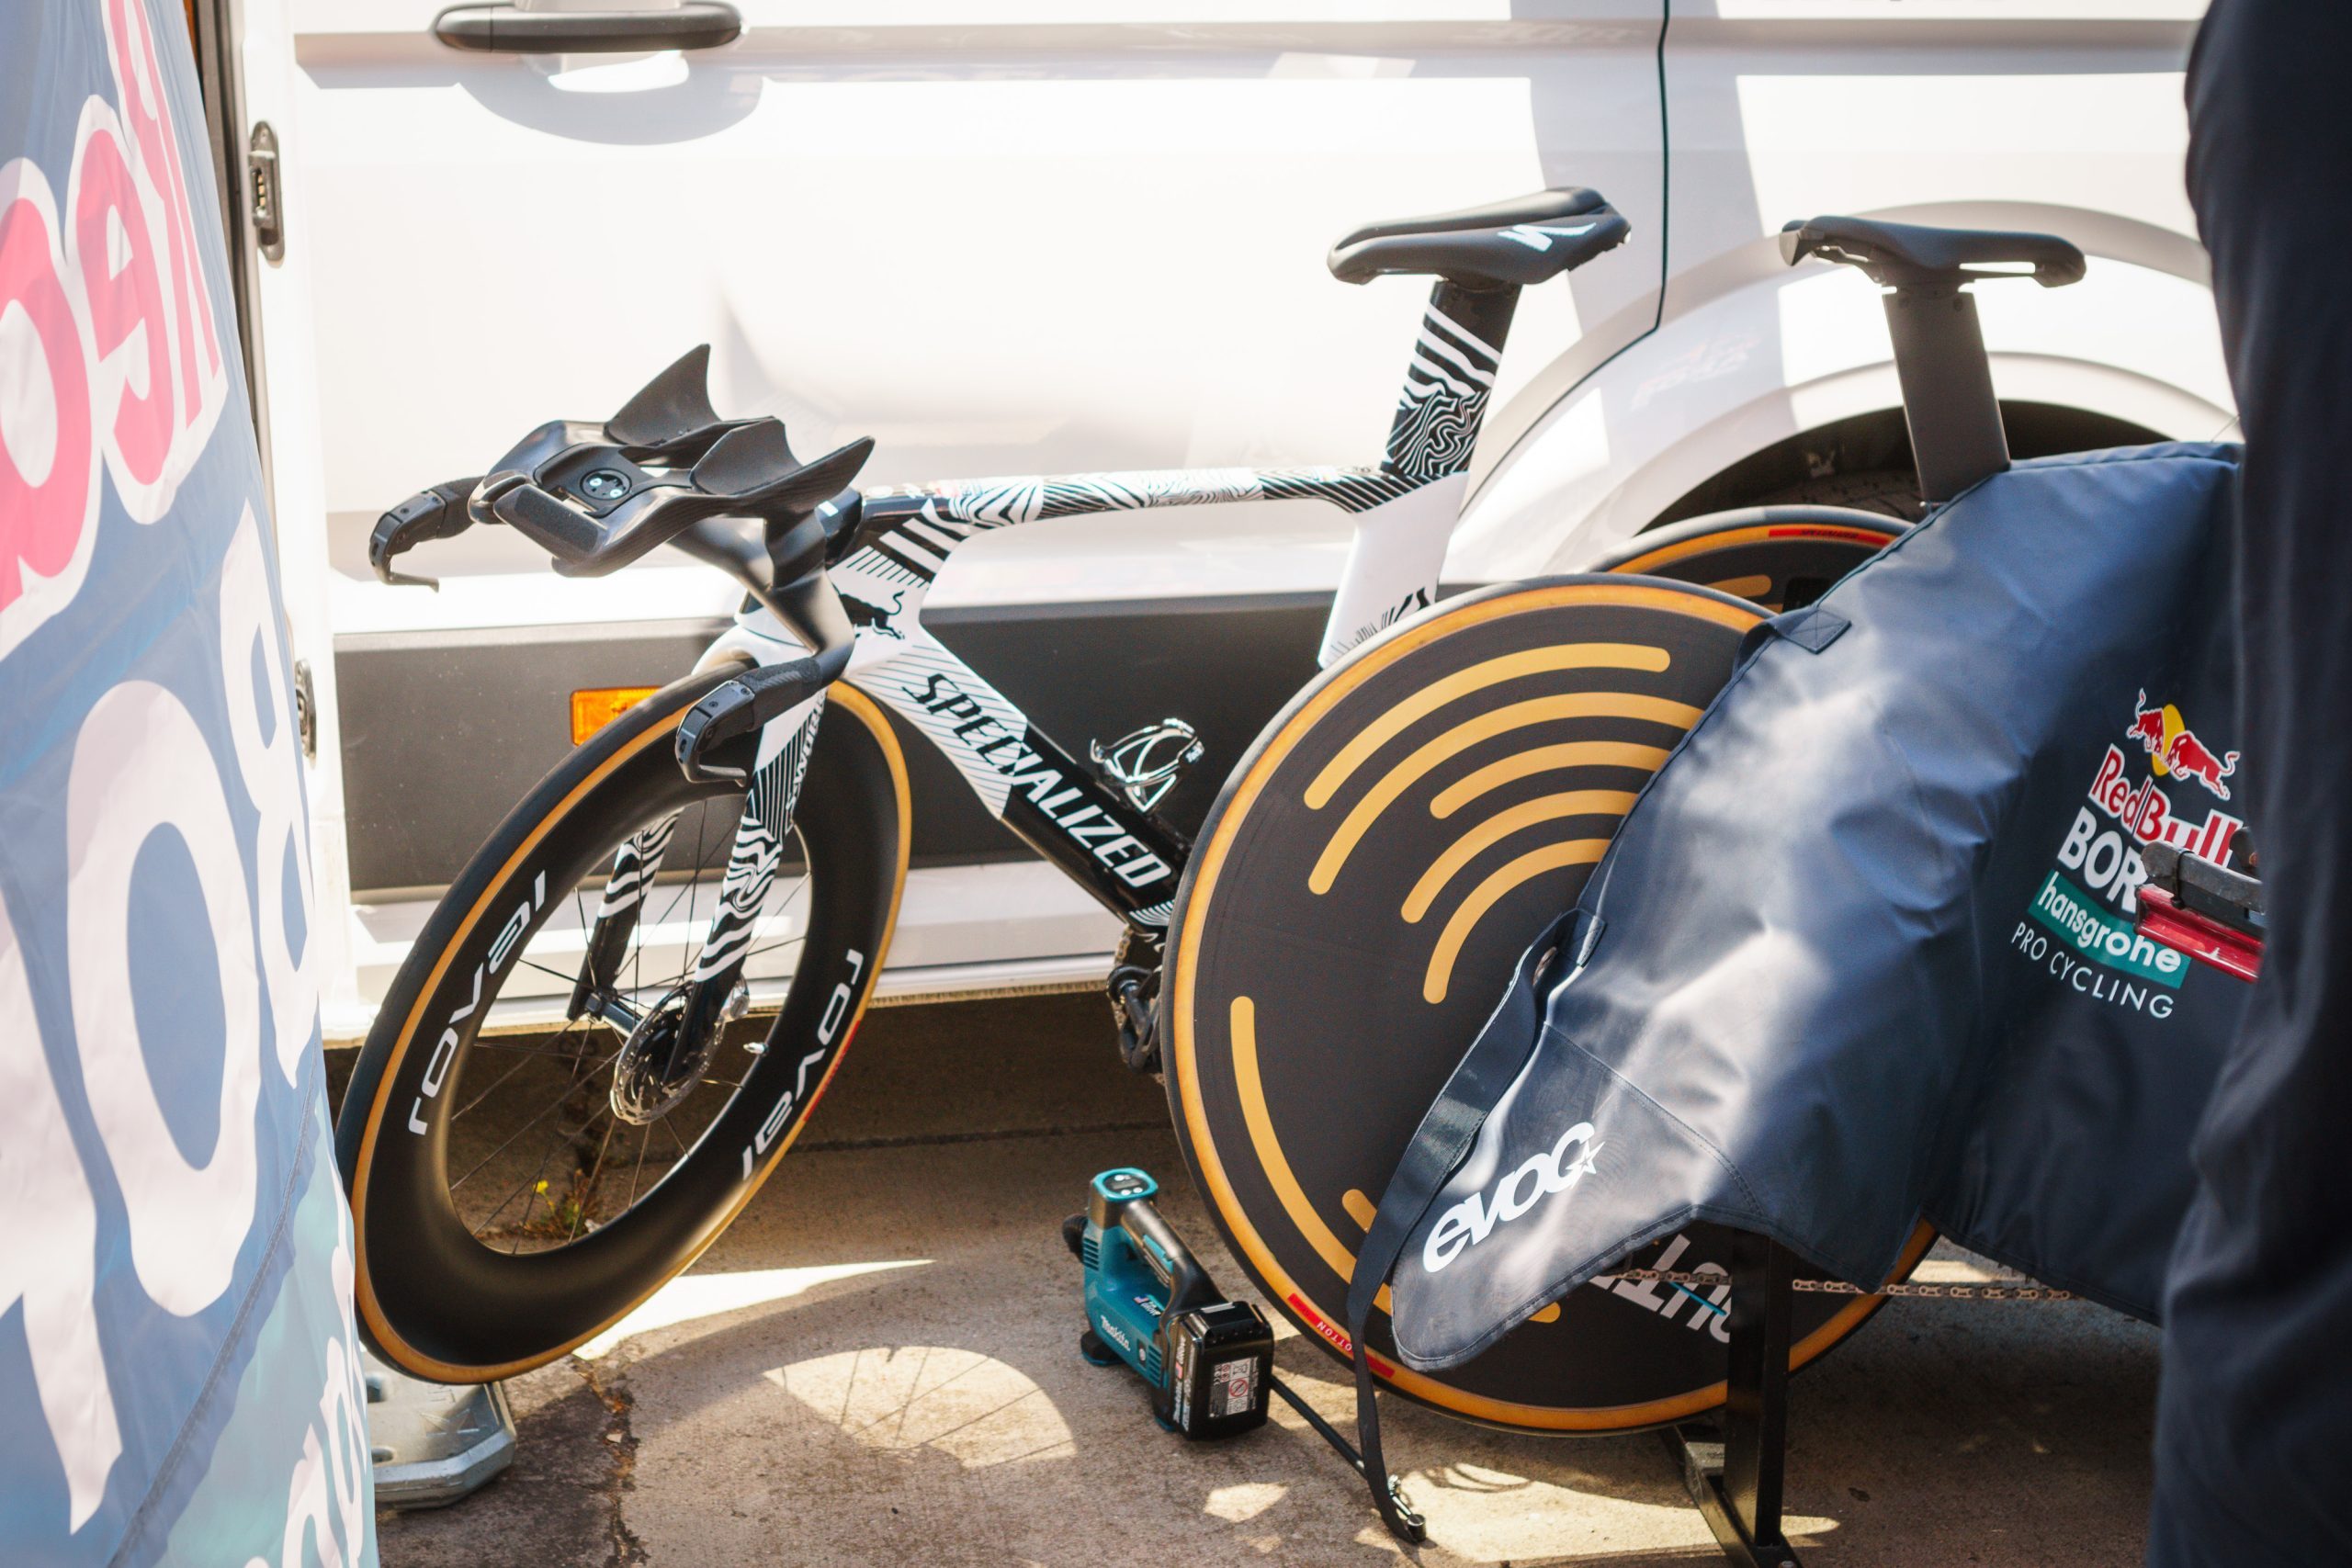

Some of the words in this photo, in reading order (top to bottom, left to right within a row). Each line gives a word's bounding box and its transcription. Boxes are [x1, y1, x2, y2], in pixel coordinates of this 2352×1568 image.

[901, 673, 1172, 888] SPECIALIZED
[2087, 743, 2153, 837] Red
[2057, 806, 2148, 913] BOR
[2011, 921, 2047, 961] PRO
[2050, 951, 2175, 1019] CYCLING
[2037, 872, 2182, 973] hansgrohe
[1316, 1321, 1352, 1352] OTTON
